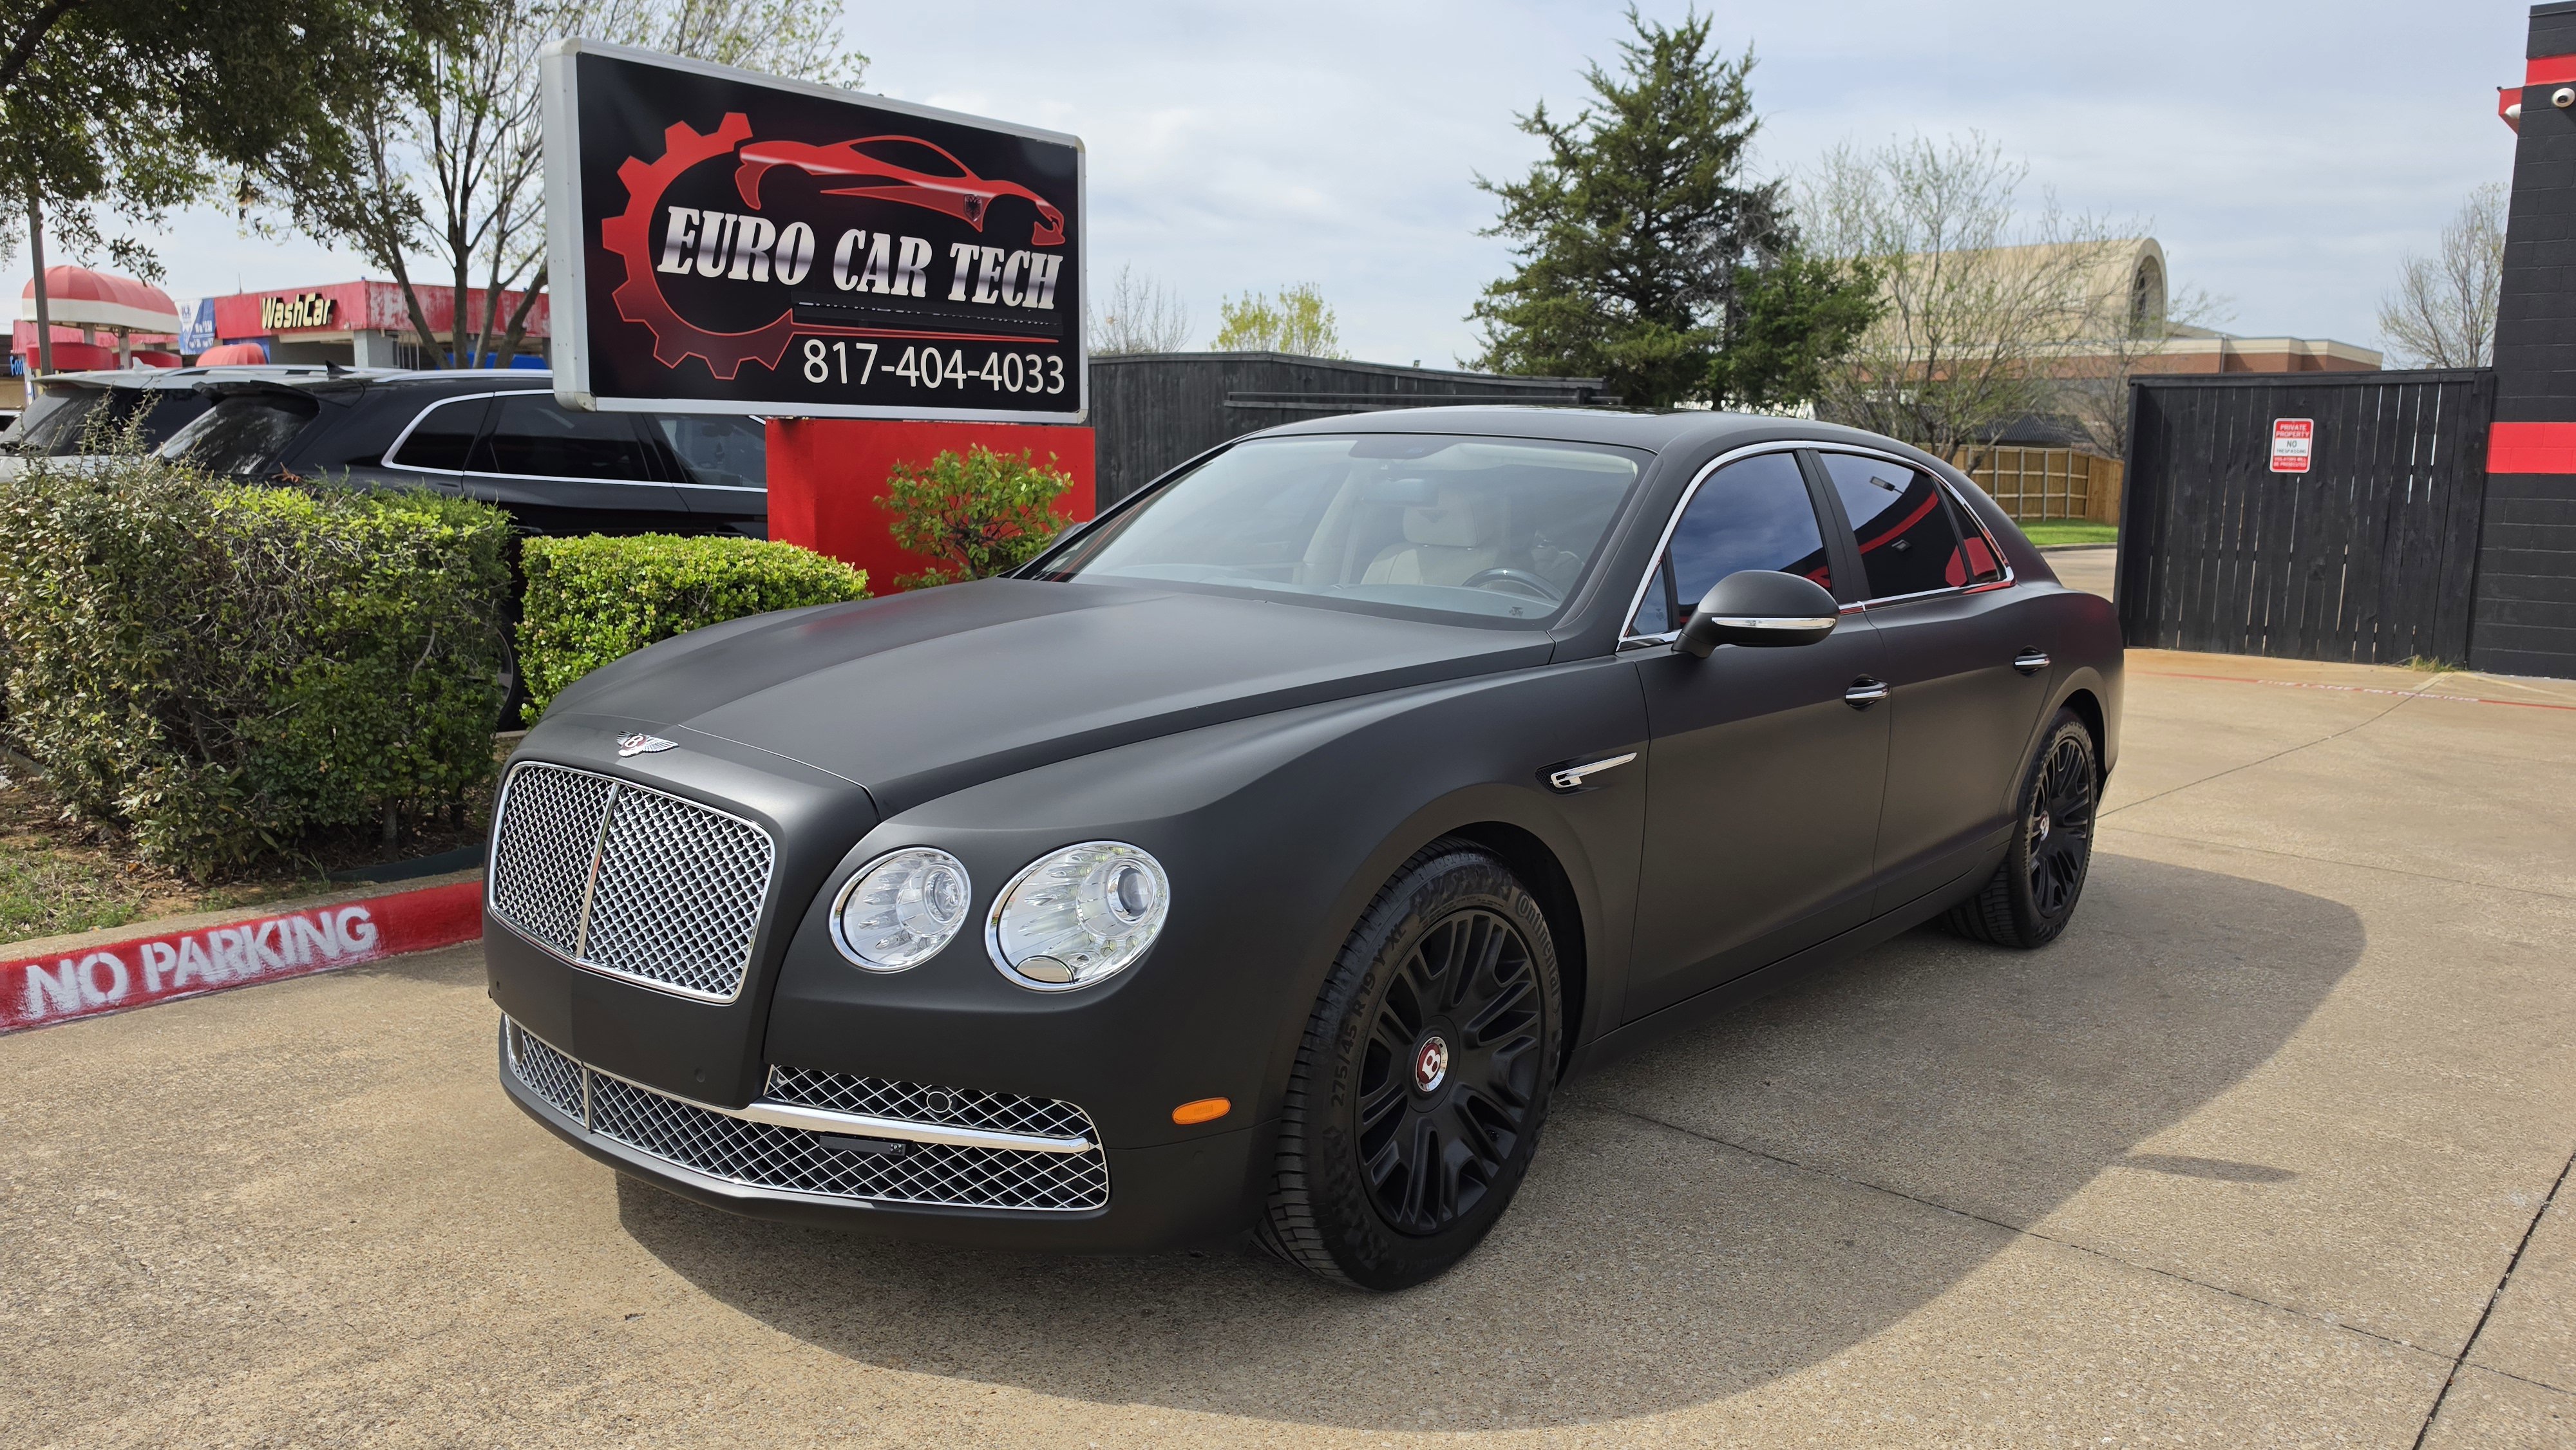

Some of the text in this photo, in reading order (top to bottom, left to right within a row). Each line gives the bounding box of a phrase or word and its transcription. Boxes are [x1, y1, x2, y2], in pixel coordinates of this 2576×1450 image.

[657, 205, 1064, 310] EURO CAR TECH
[261, 292, 331, 330] WashCar
[804, 339, 1065, 394] 817-404-4033
[25, 905, 378, 1020] NO PARKING
[1514, 890, 1561, 999] Continental
[1331, 922, 1407, 1107] 275/45 R 19 Y XL
[1422, 1049, 1441, 1080] B
